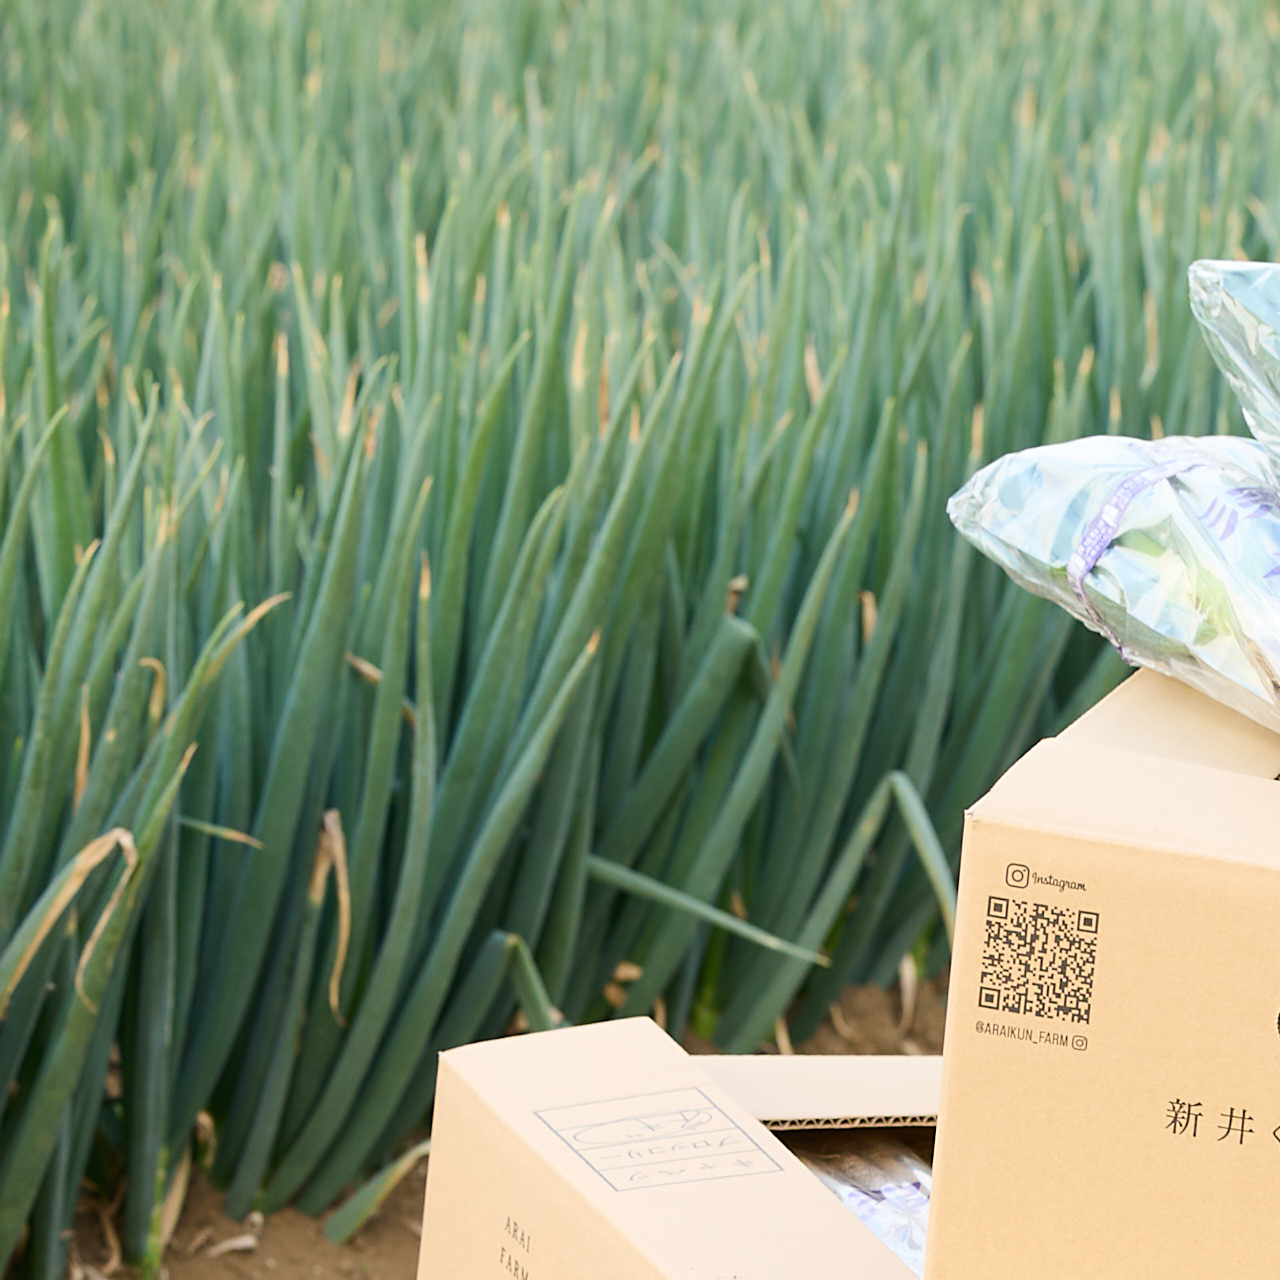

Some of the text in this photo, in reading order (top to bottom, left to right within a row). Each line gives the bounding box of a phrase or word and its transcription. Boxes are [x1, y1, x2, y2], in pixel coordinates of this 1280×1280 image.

[1030, 871, 1088, 894] Instagram
[974, 1019, 1070, 1049] @ARAIKUN_FARM
[503, 1214, 532, 1254] ARAI
